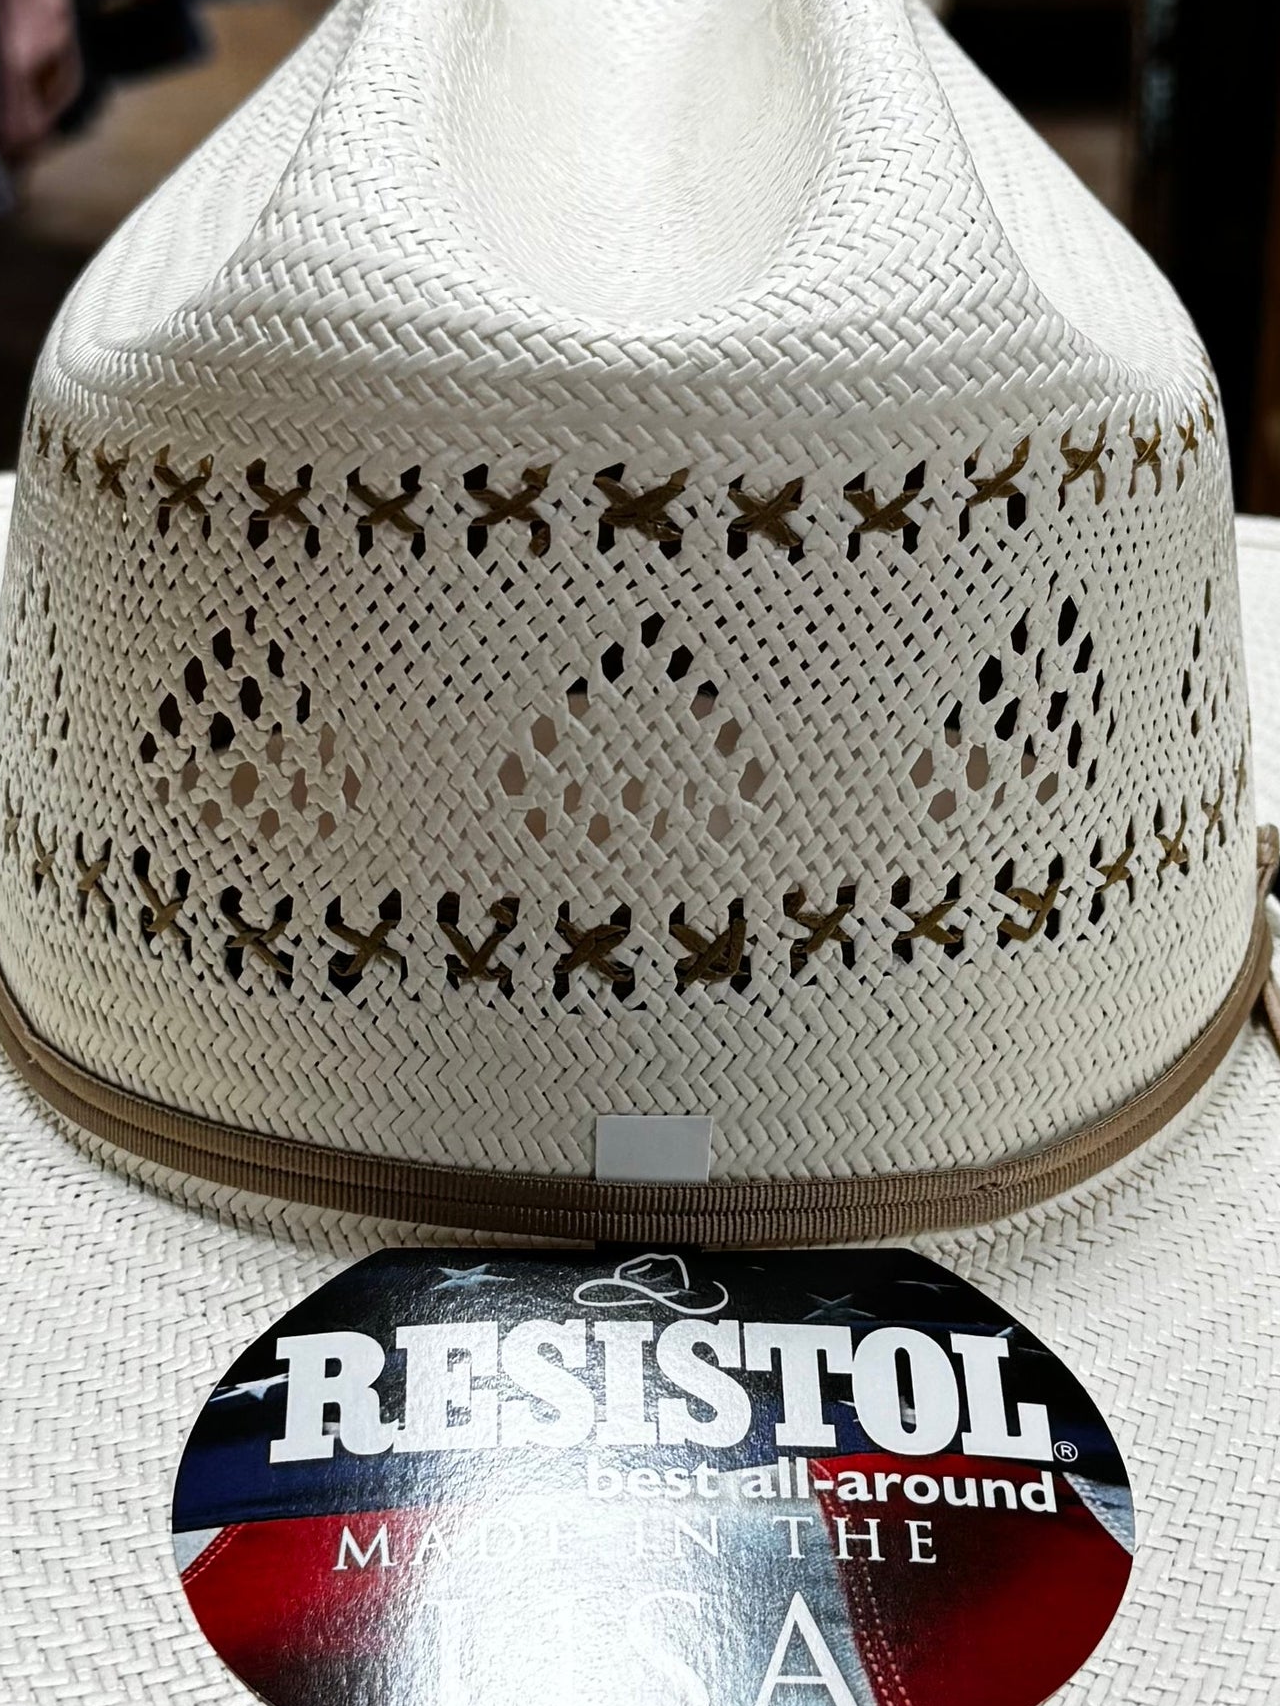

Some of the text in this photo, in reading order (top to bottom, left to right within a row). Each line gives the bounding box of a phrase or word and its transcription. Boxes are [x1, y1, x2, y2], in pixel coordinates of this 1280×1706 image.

[586, 1456, 1058, 1514] best all-around
[634, 1515, 720, 1560] IN
[773, 1515, 938, 1564] THE
